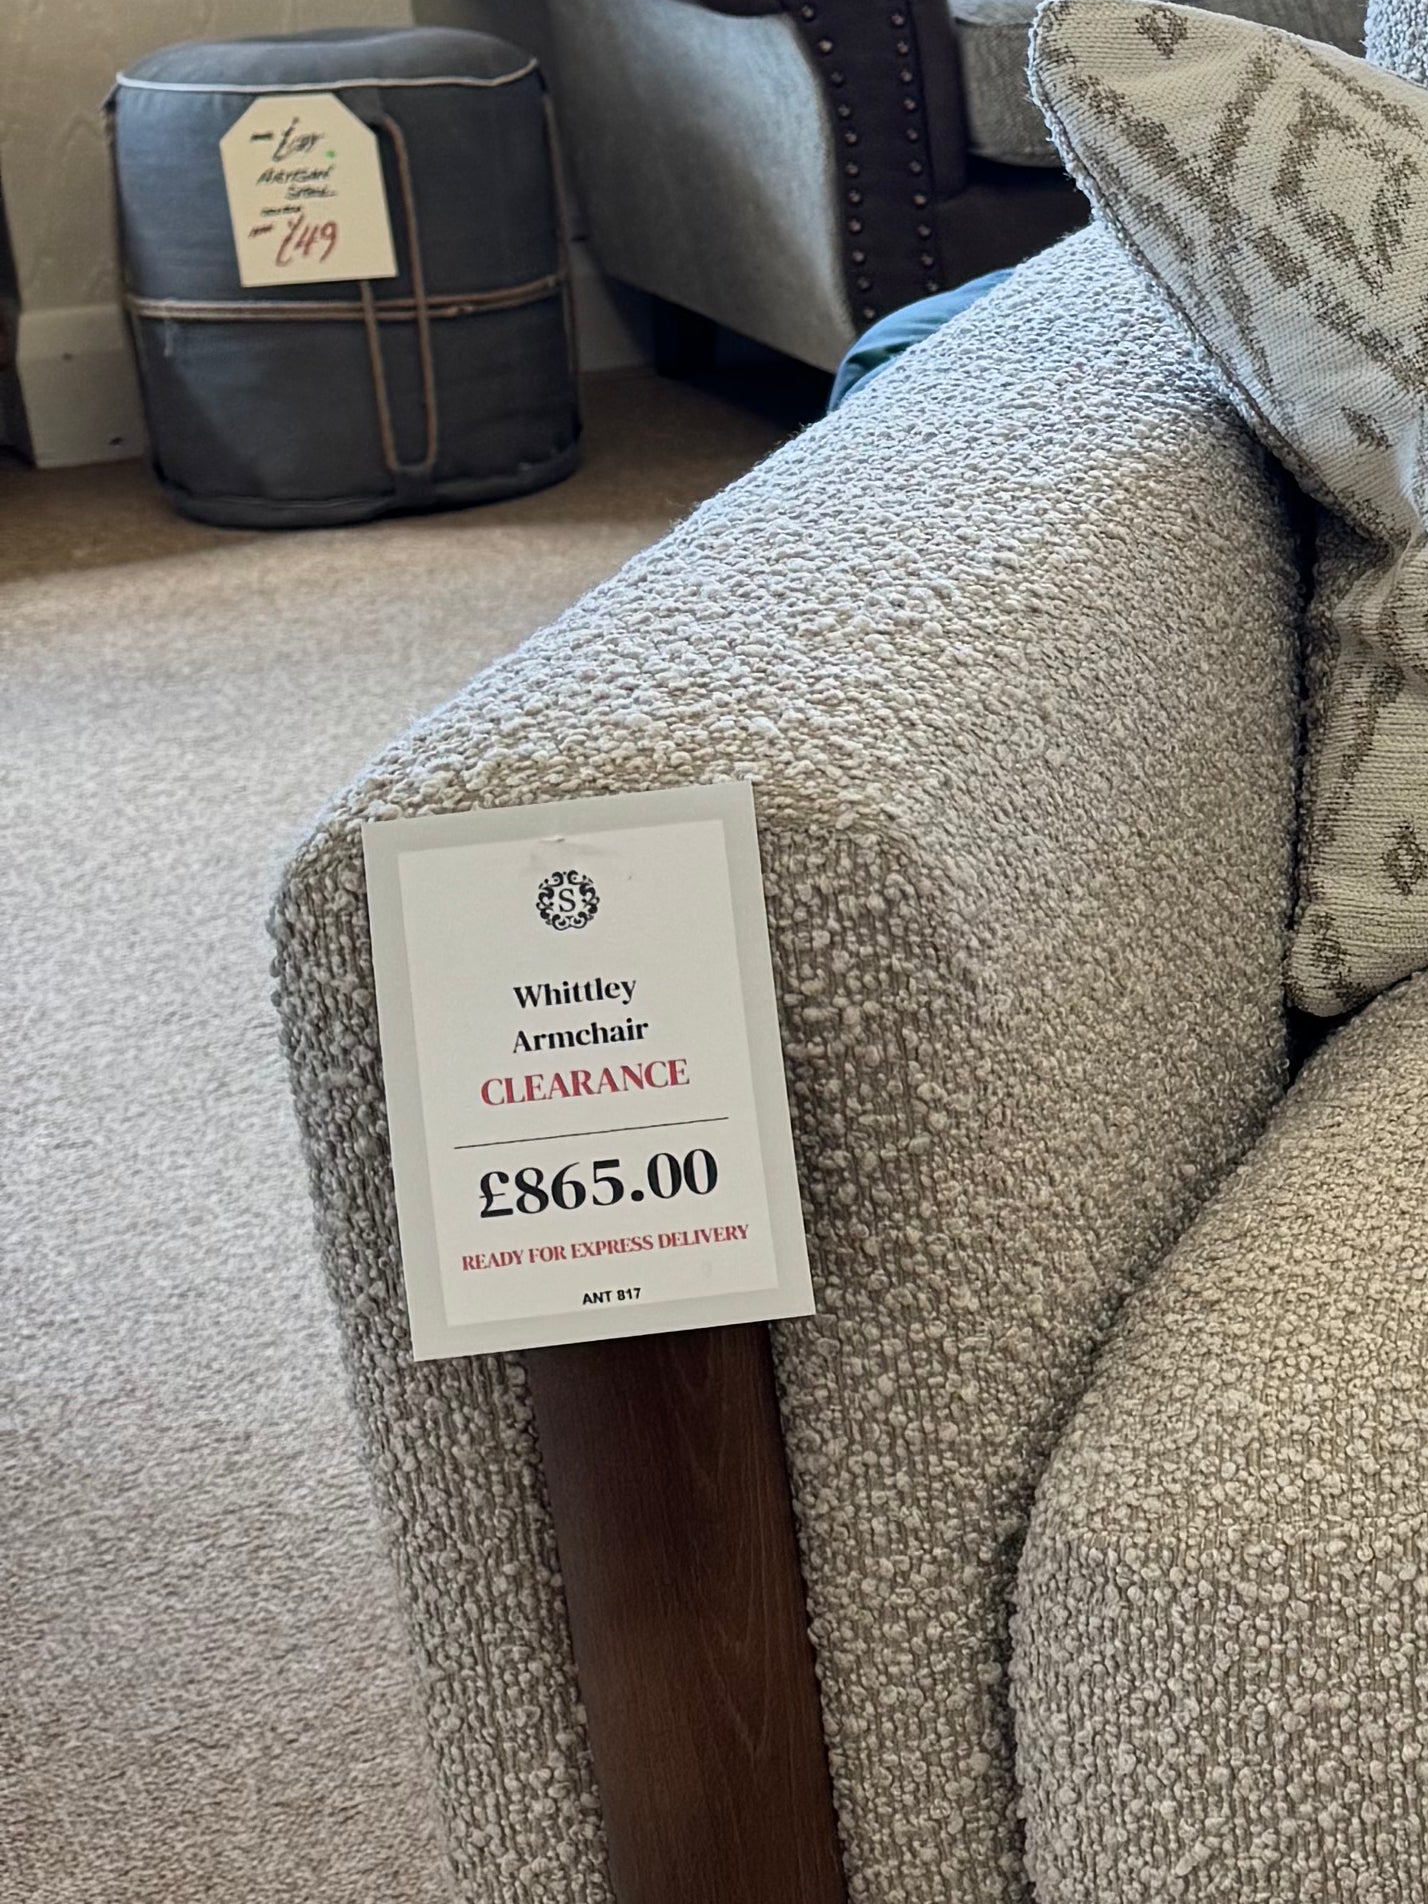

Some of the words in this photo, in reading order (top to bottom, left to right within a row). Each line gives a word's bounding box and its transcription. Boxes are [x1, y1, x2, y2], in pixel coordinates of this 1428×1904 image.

[512, 976, 638, 1009] Whittley
[511, 1017, 650, 1055] Armchair
[479, 1057, 691, 1108] CLEARANCE
[478, 1147, 720, 1219] £865.00
[461, 1248, 525, 1272] READY
[528, 1243, 567, 1265] FOR
[570, 1234, 655, 1262] EXPRESS
[657, 1222, 751, 1249] DELIVERY
[581, 1289, 614, 1306] ANT
[616, 1286, 643, 1303] 817
